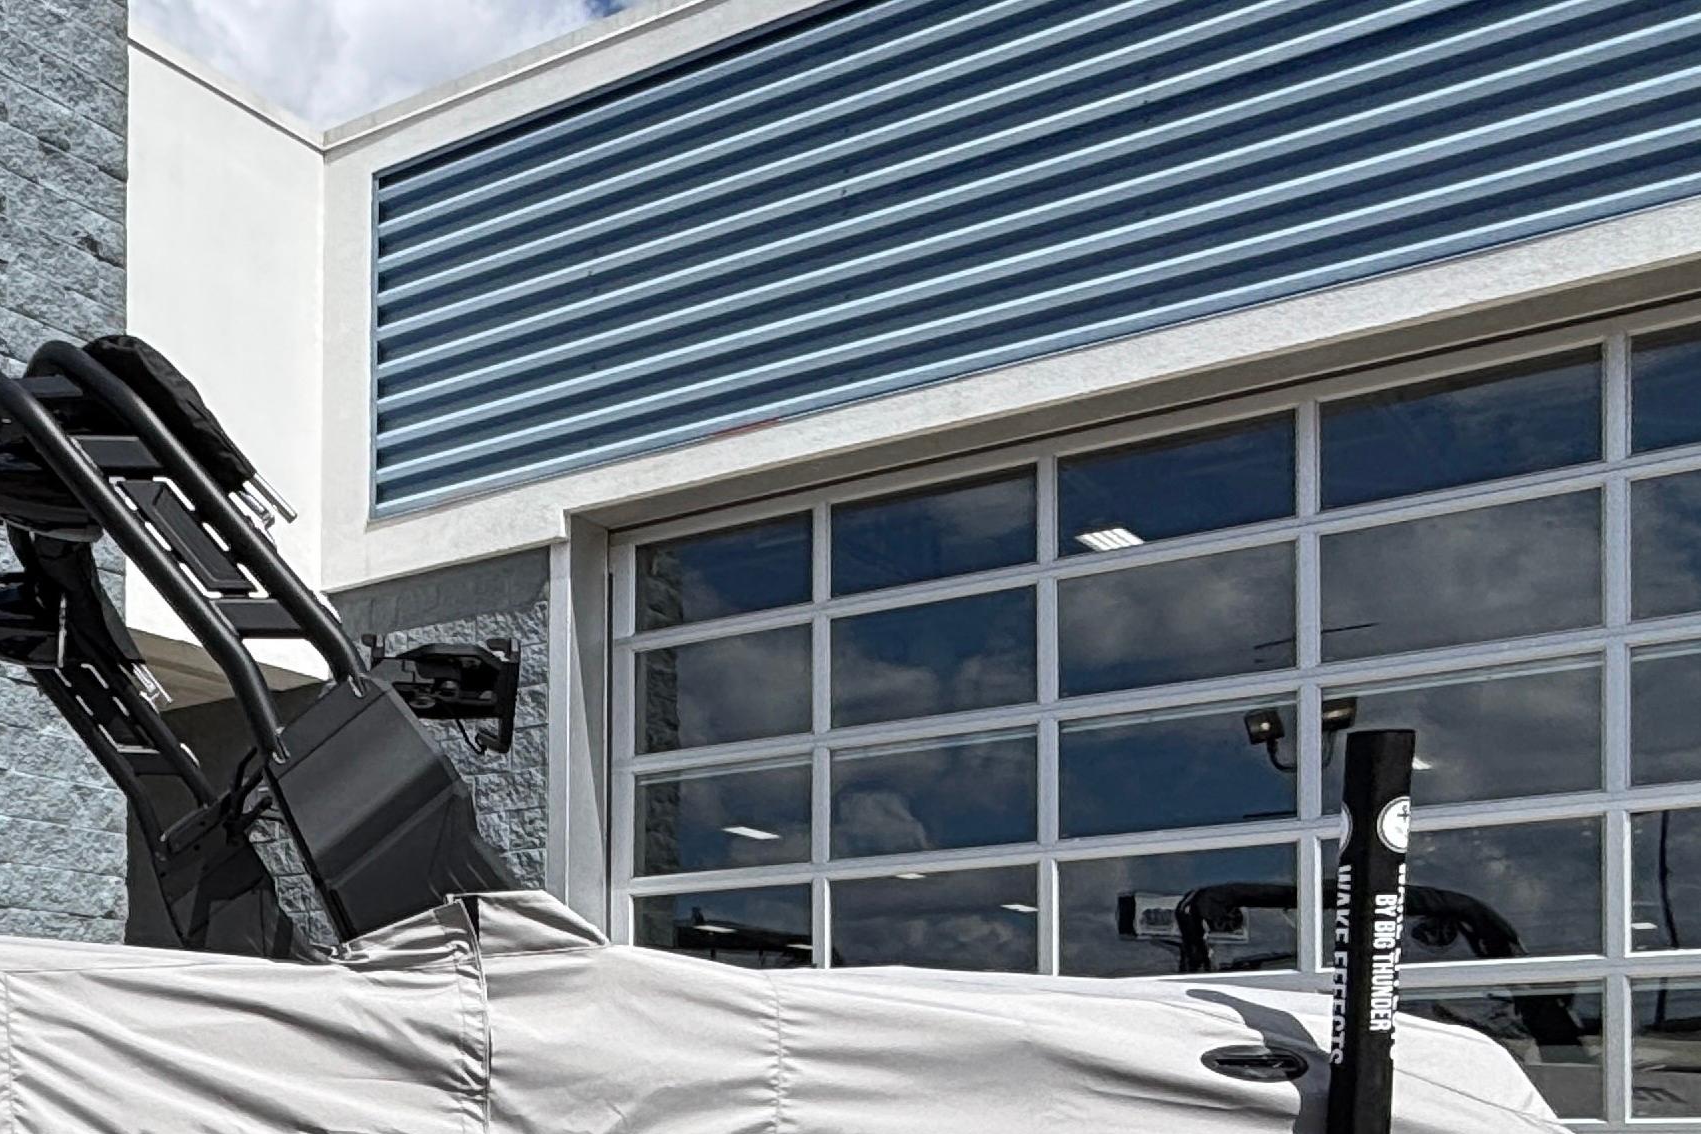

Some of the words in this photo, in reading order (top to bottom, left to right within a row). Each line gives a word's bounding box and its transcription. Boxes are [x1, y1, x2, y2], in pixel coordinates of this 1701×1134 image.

[1375, 894, 1398, 917] BY
[1372, 920, 1396, 949] BIG
[1369, 951, 1395, 1031] THUNDER
